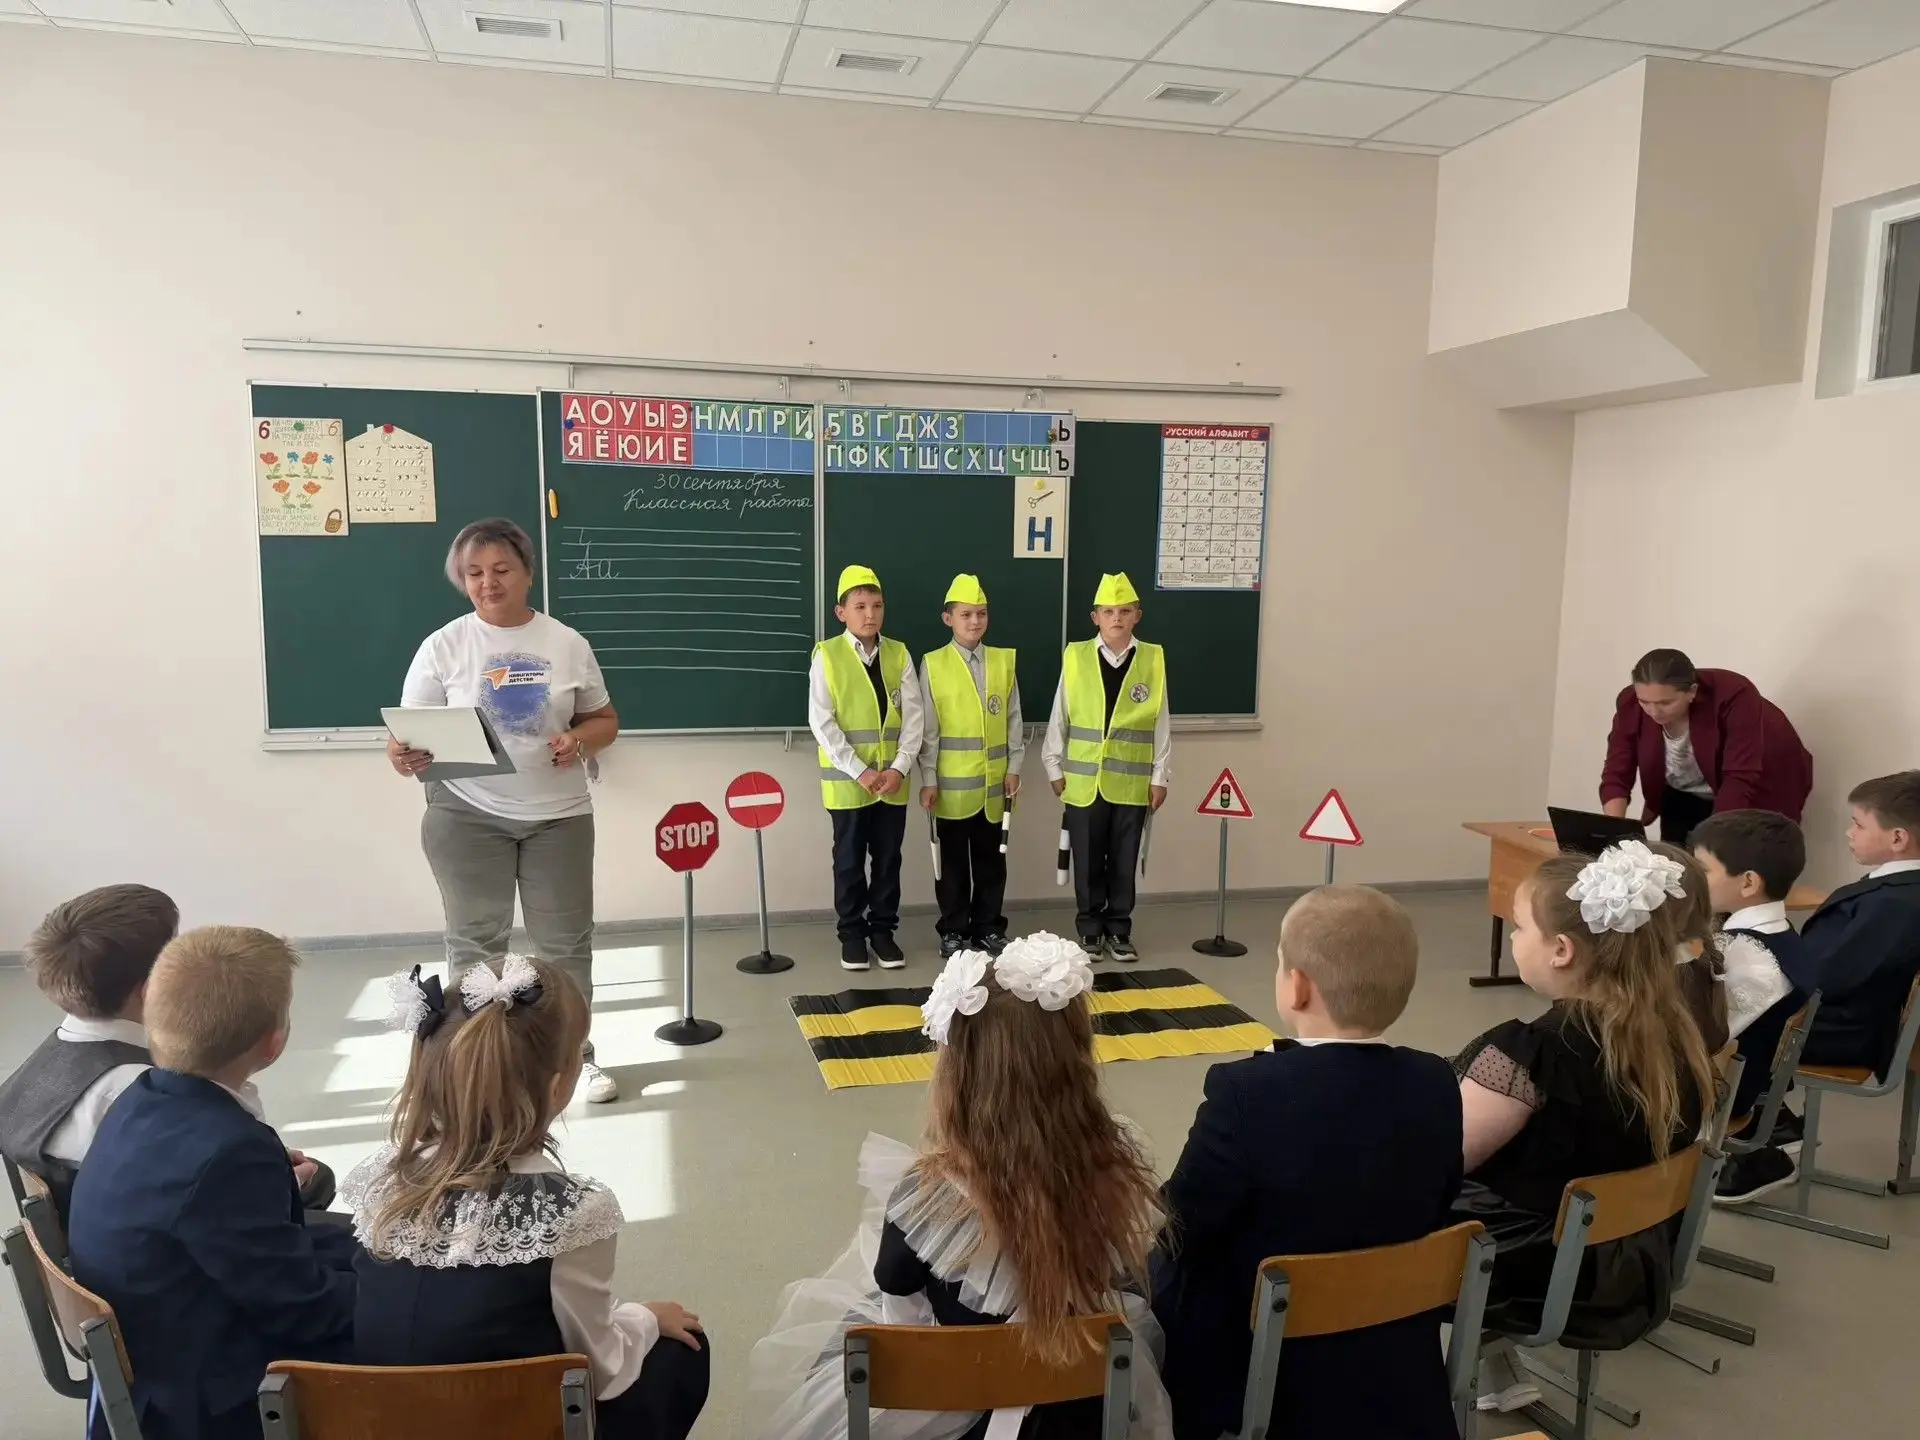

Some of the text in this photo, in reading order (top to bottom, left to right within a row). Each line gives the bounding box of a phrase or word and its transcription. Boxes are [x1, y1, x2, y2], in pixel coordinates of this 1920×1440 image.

[258, 420, 271, 439] 6
[1165, 427, 1249, 438] РУССКИЙ АЛФАВИТ
[654, 472, 786, 496] 30 сентября
[623, 488, 813, 519] Классная работа
[1027, 517, 1052, 552] Н
[660, 820, 715, 851] STOP
